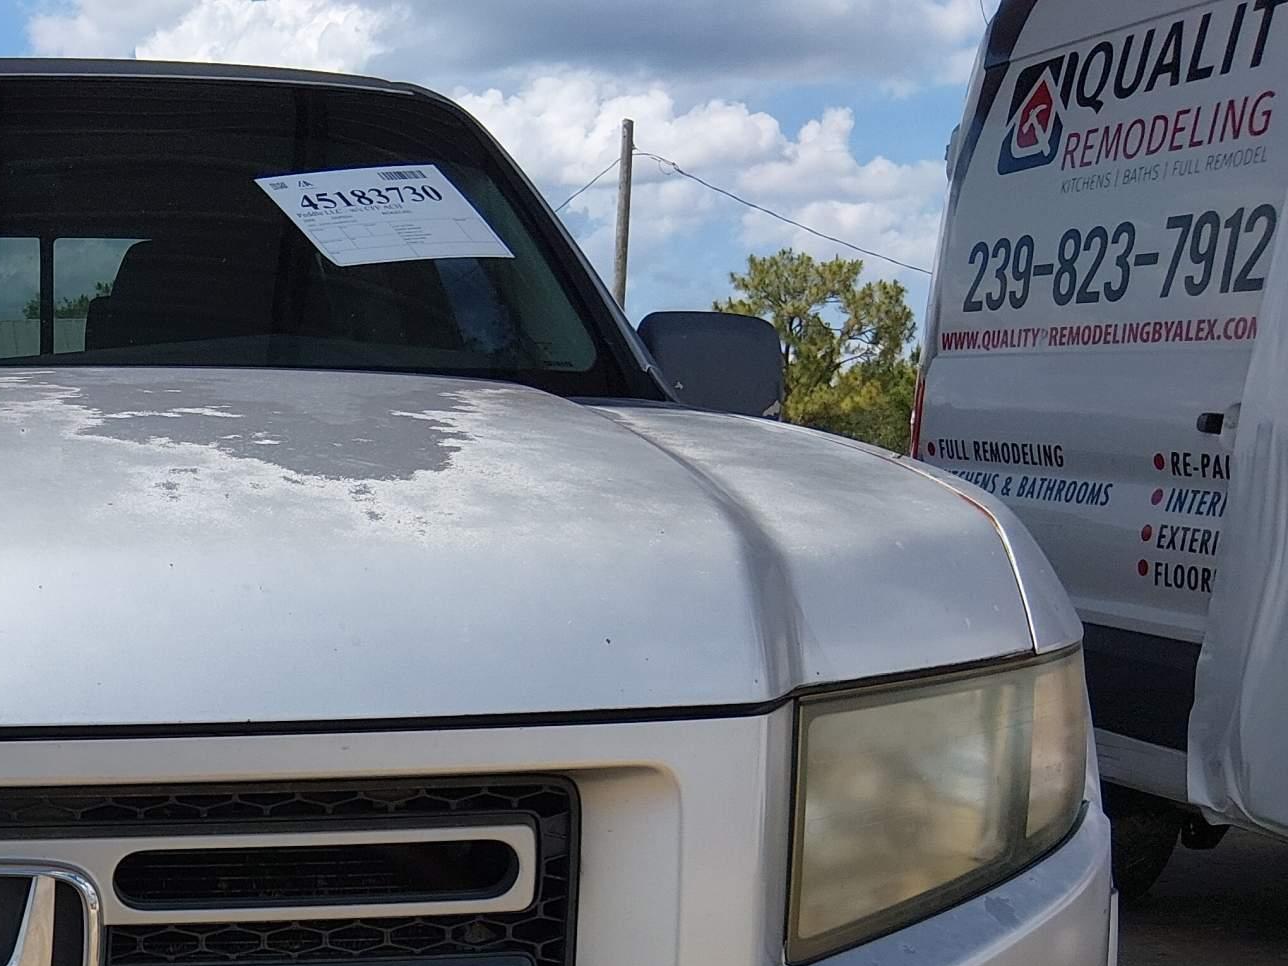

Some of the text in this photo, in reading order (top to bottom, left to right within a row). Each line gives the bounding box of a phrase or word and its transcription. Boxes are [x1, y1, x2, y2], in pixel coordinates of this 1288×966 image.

[1061, 90, 1276, 171] REMODELING
[1060, 172, 1112, 194] KITCHENS
[1122, 164, 1160, 185] BATHS
[1171, 159, 1201, 177] FULL
[1204, 146, 1268, 171] REMODEL
[300, 184, 442, 211] 45183730
[962, 203, 1278, 313] 239-823-7912
[938, 438, 1065, 468] FULL REMODELING
[1170, 451, 1231, 481] RE-PAI
[1016, 475, 1114, 506] BATHROOMS
[1156, 523, 1220, 556] EXTERI
